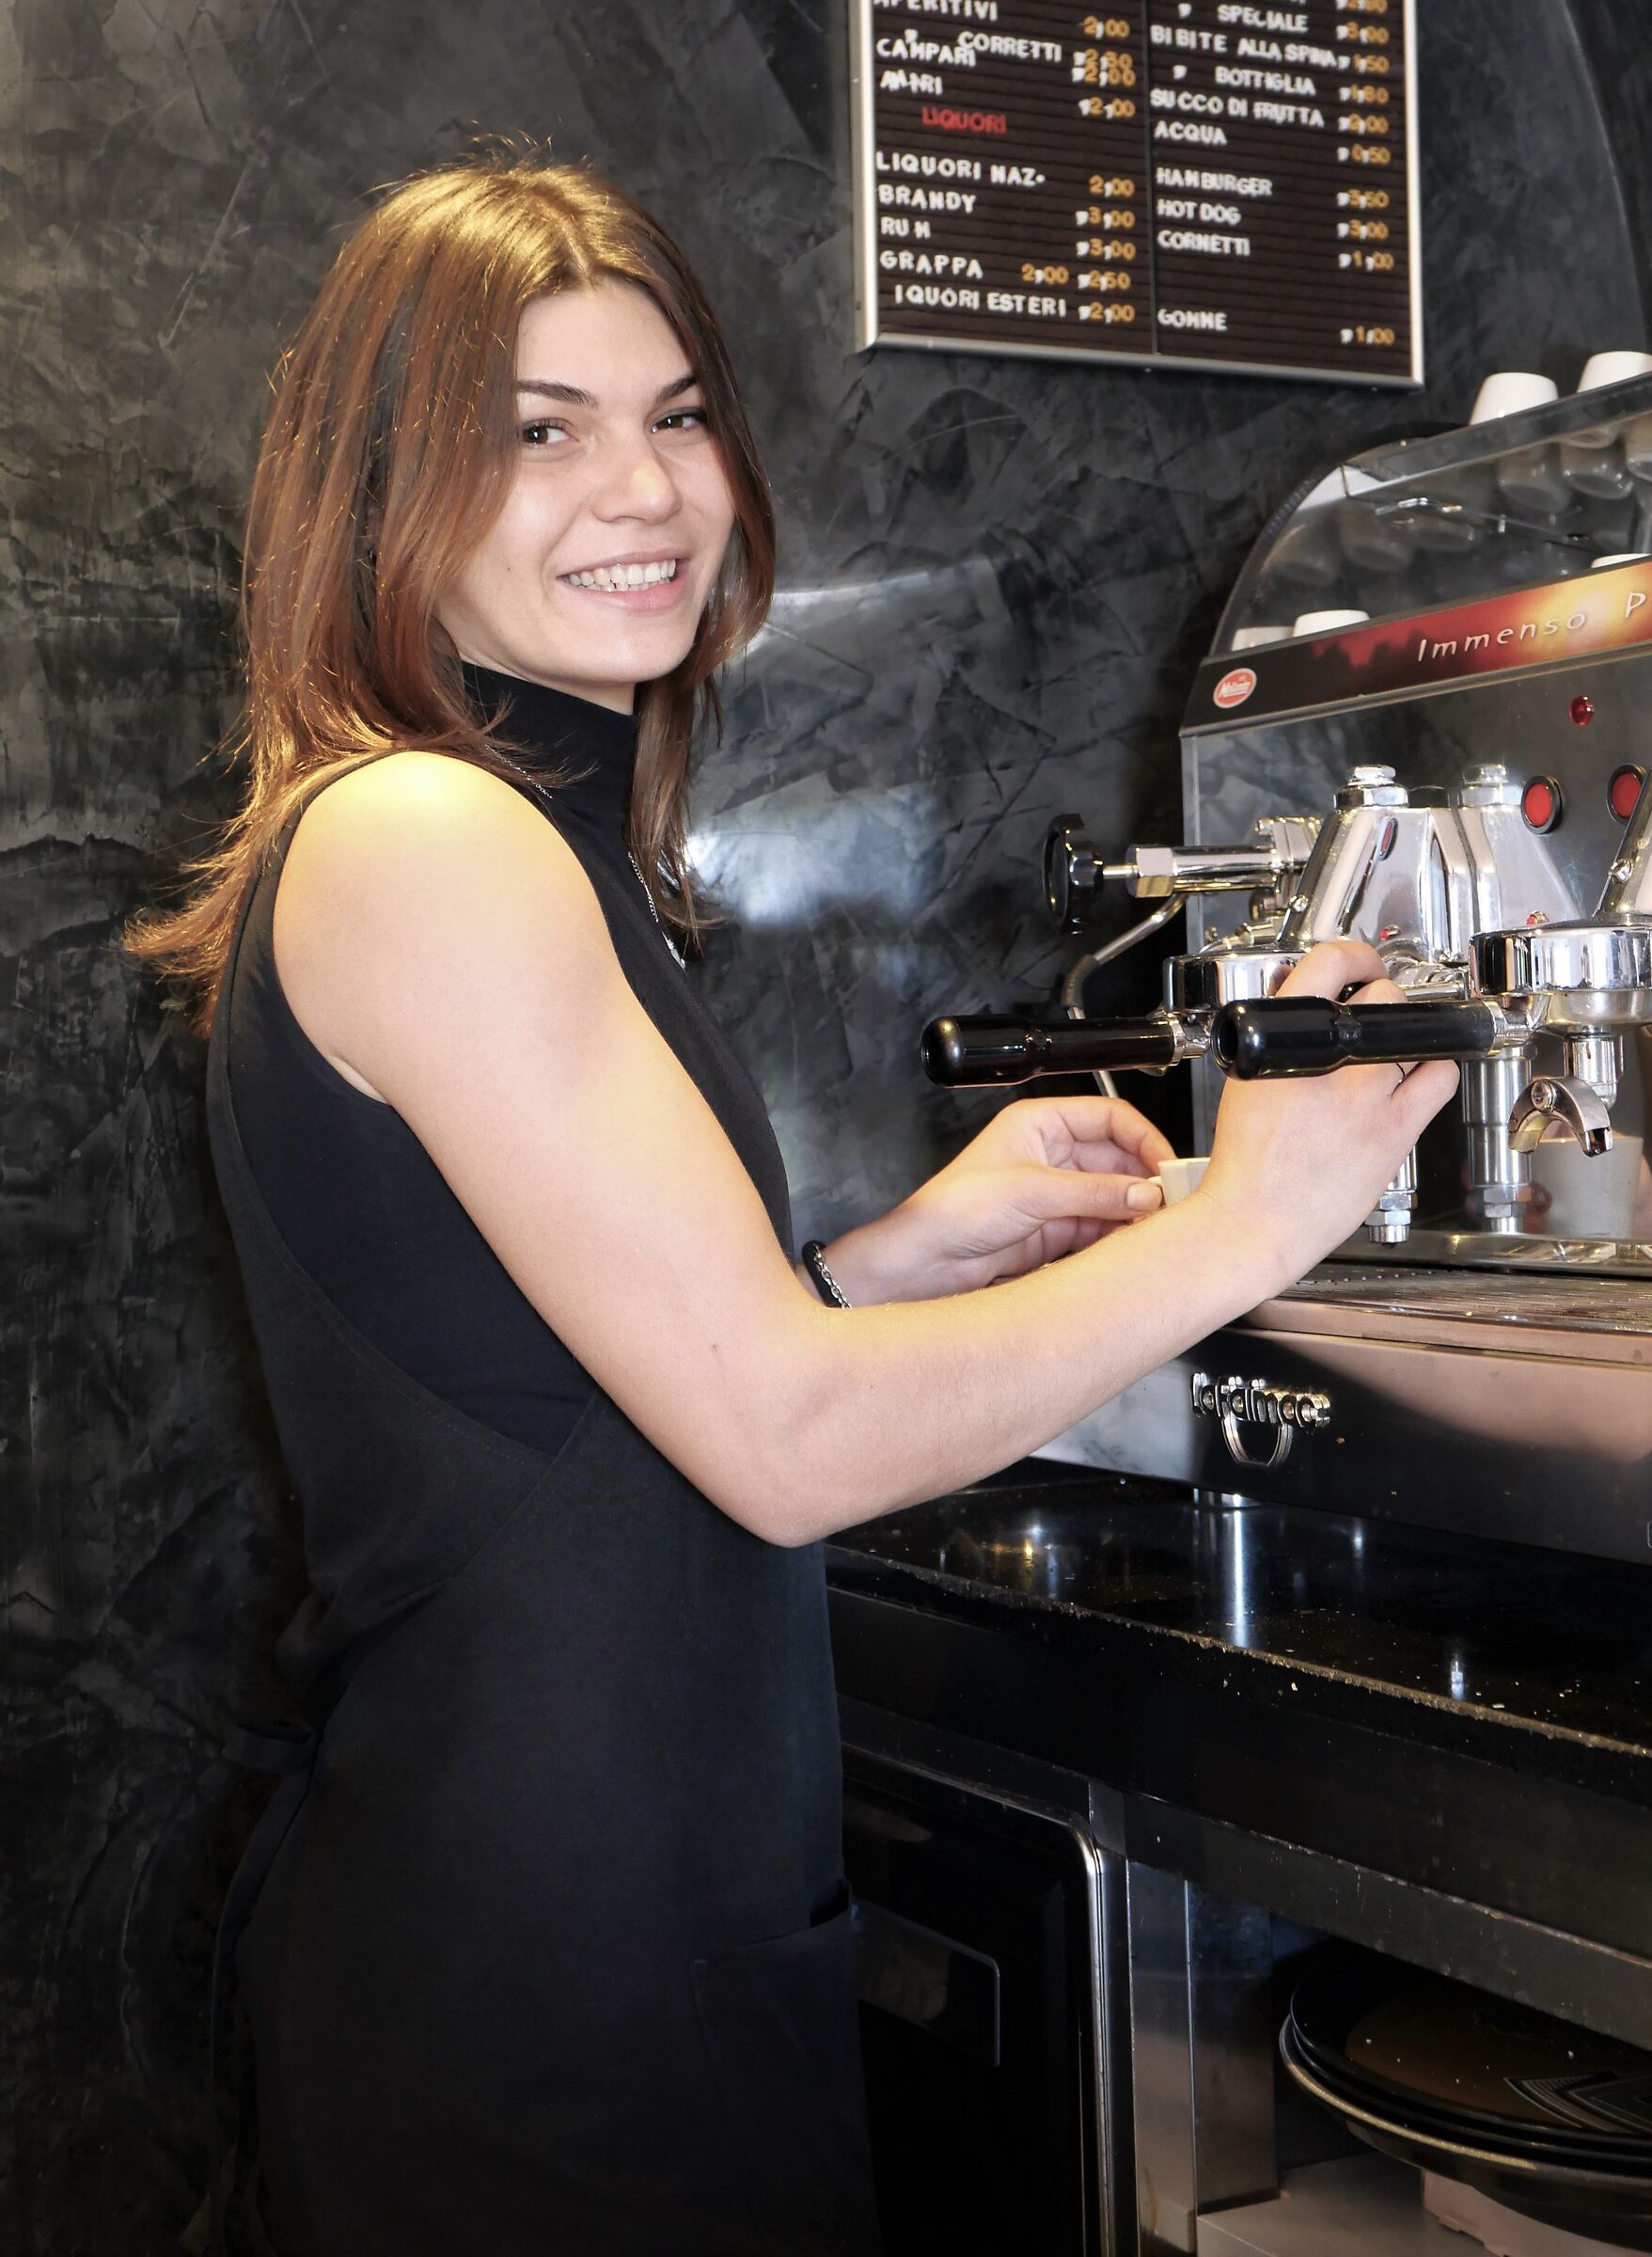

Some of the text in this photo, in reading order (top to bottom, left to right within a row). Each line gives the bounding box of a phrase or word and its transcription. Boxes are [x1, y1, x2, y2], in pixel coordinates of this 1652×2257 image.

[957, 31, 1062, 63] CORRETTI
[1215, 65, 1316, 96] BOTTIGLIA
[921, 106, 1007, 135] LIQUORI
[1227, 97, 1249, 118] DI
[1154, 120, 1228, 146] ACQUA
[876, 150, 981, 181] LIQUORI
[1156, 166, 1273, 197] HAMBURGER
[877, 183, 976, 213] BRANDY
[1156, 198, 1197, 222] HOT
[1199, 202, 1241, 227] DOG
[1156, 229, 1251, 257] CORNETTI
[879, 250, 983, 280] GRAPPA
[987, 292, 1066, 318] ESTERI
[1417, 610, 1586, 662] Immenso
